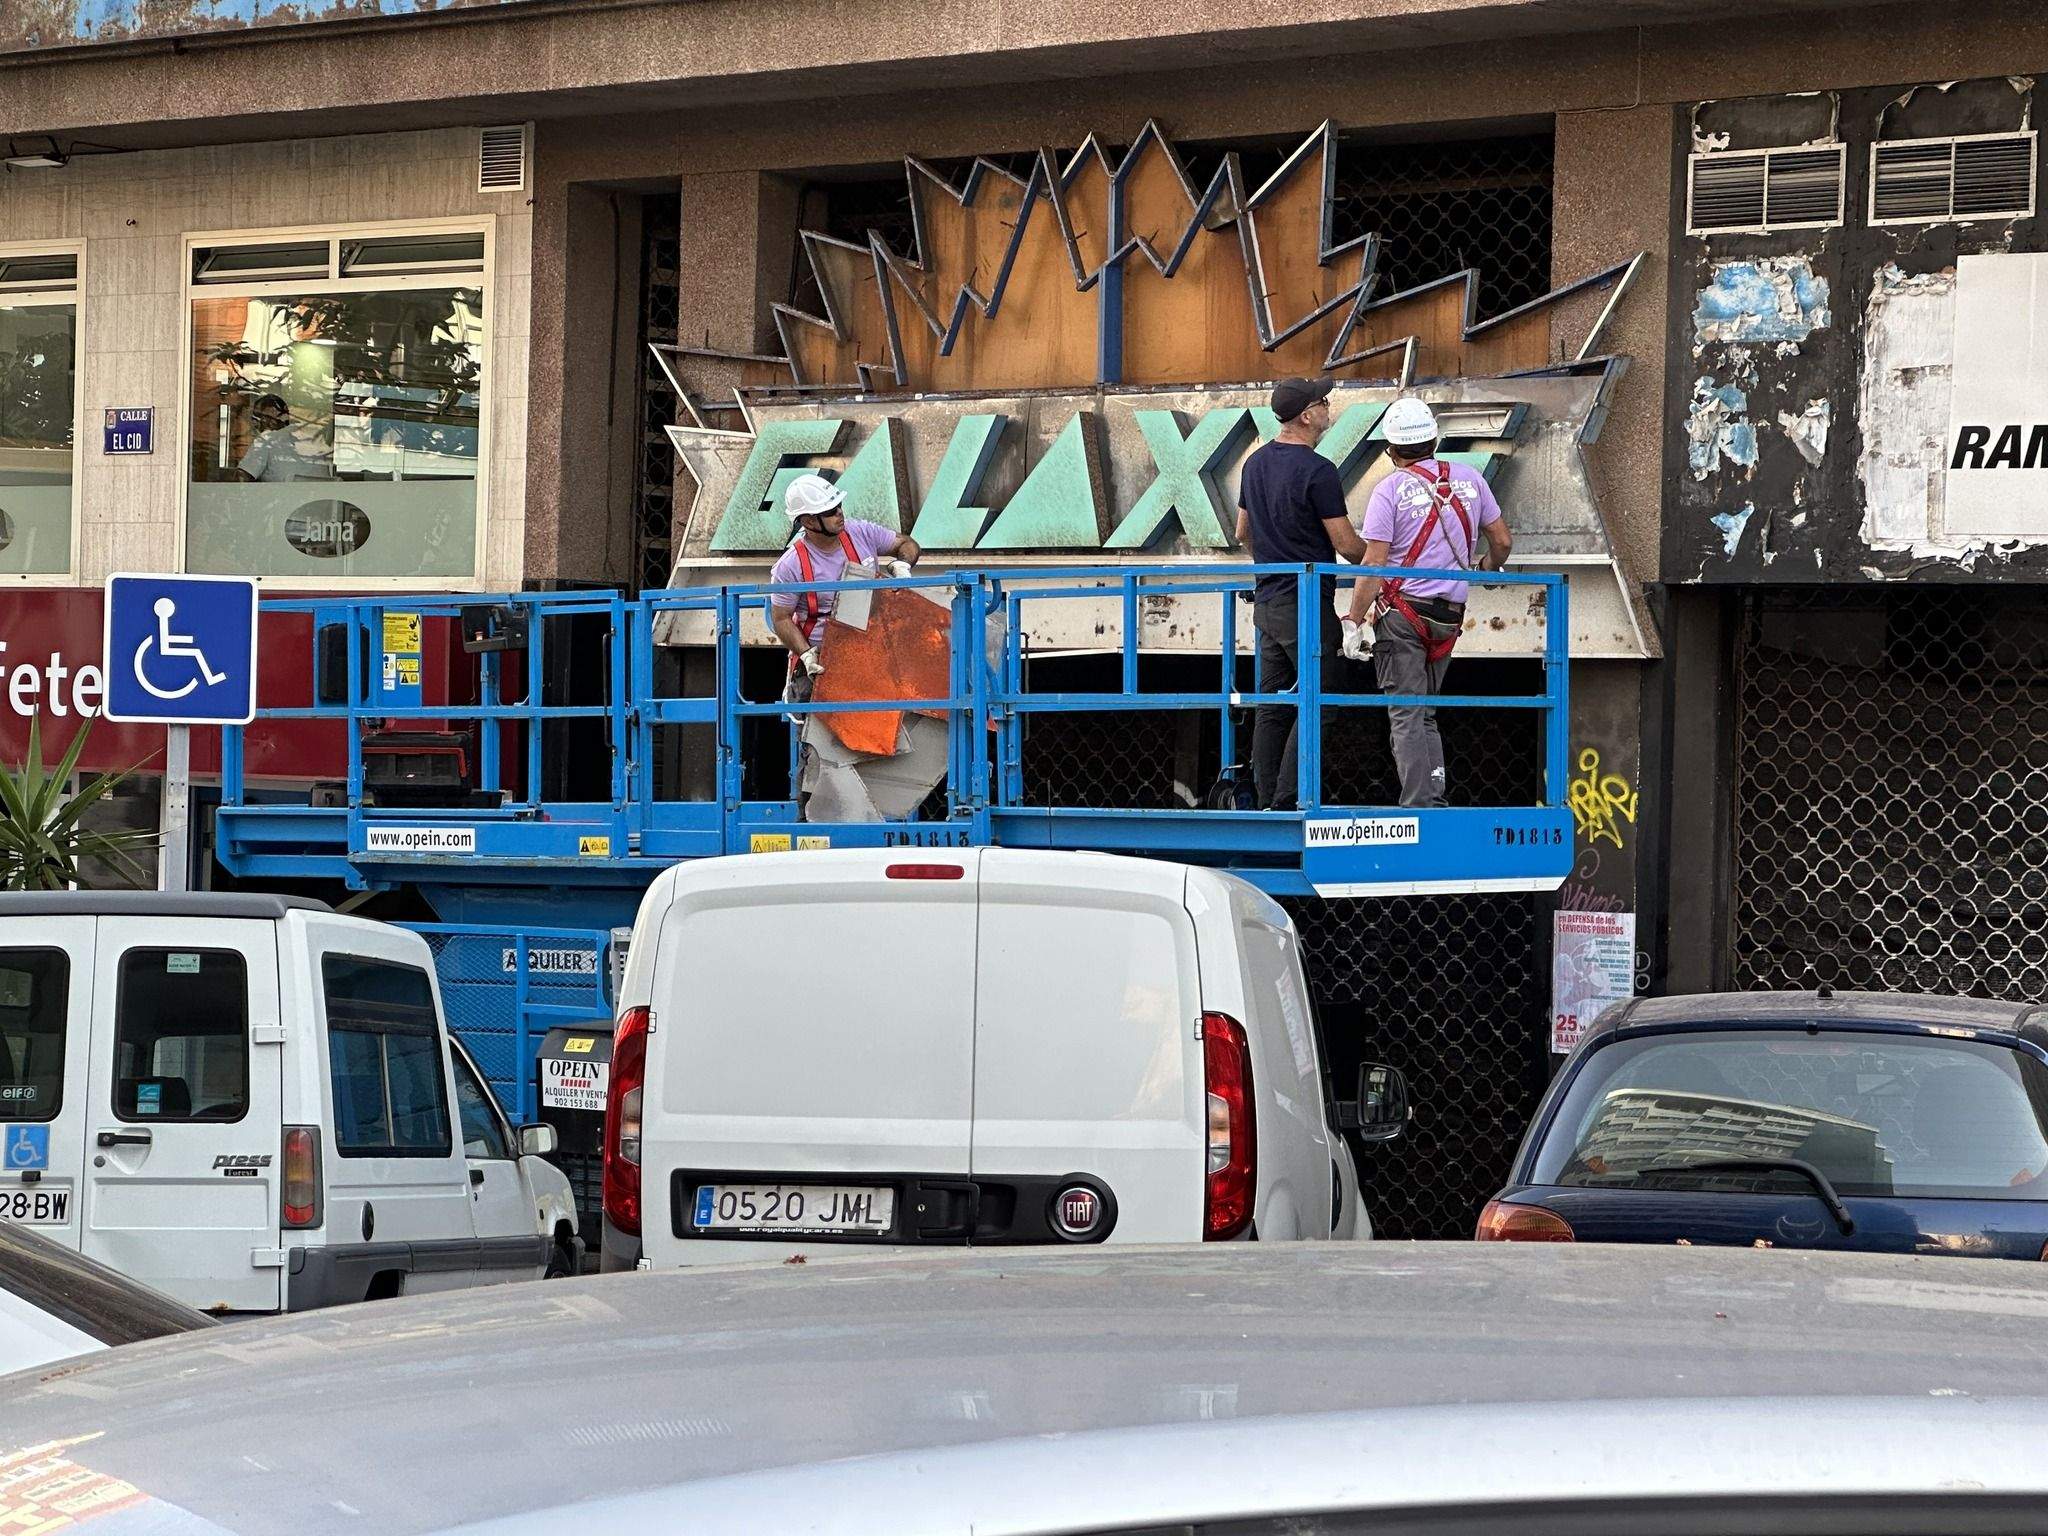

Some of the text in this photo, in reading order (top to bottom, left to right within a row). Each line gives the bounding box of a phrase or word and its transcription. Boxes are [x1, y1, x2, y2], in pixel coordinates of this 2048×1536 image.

[120, 410, 148, 421] CALLE
[113, 432, 142, 450] EL CID
[709, 402, 1530, 551] GALAXY
[301, 516, 354, 542] Jama
[0, 641, 103, 718] ete
[370, 829, 472, 849] www.opein.com
[1309, 820, 1415, 843] www.opein.com
[1558, 923, 1591, 934] SERVICIOS
[1567, 914, 1595, 924] DEFENSA
[1596, 915, 1604, 924] de
[1605, 915, 1616, 925] los
[506, 951, 582, 971] AQUILER
[1556, 1014, 1577, 1032] 25
[550, 1060, 601, 1079] OPEIN
[2, 1087, 23, 1099] elf
[545, 1087, 607, 1100] ALQUILER Y VENTA
[554, 1097, 598, 1109] 902 153 688
[212, 1154, 273, 1170] press
[700, 1191, 883, 1224] E 0520 JML
[1066, 1201, 1092, 1222] FIAT
